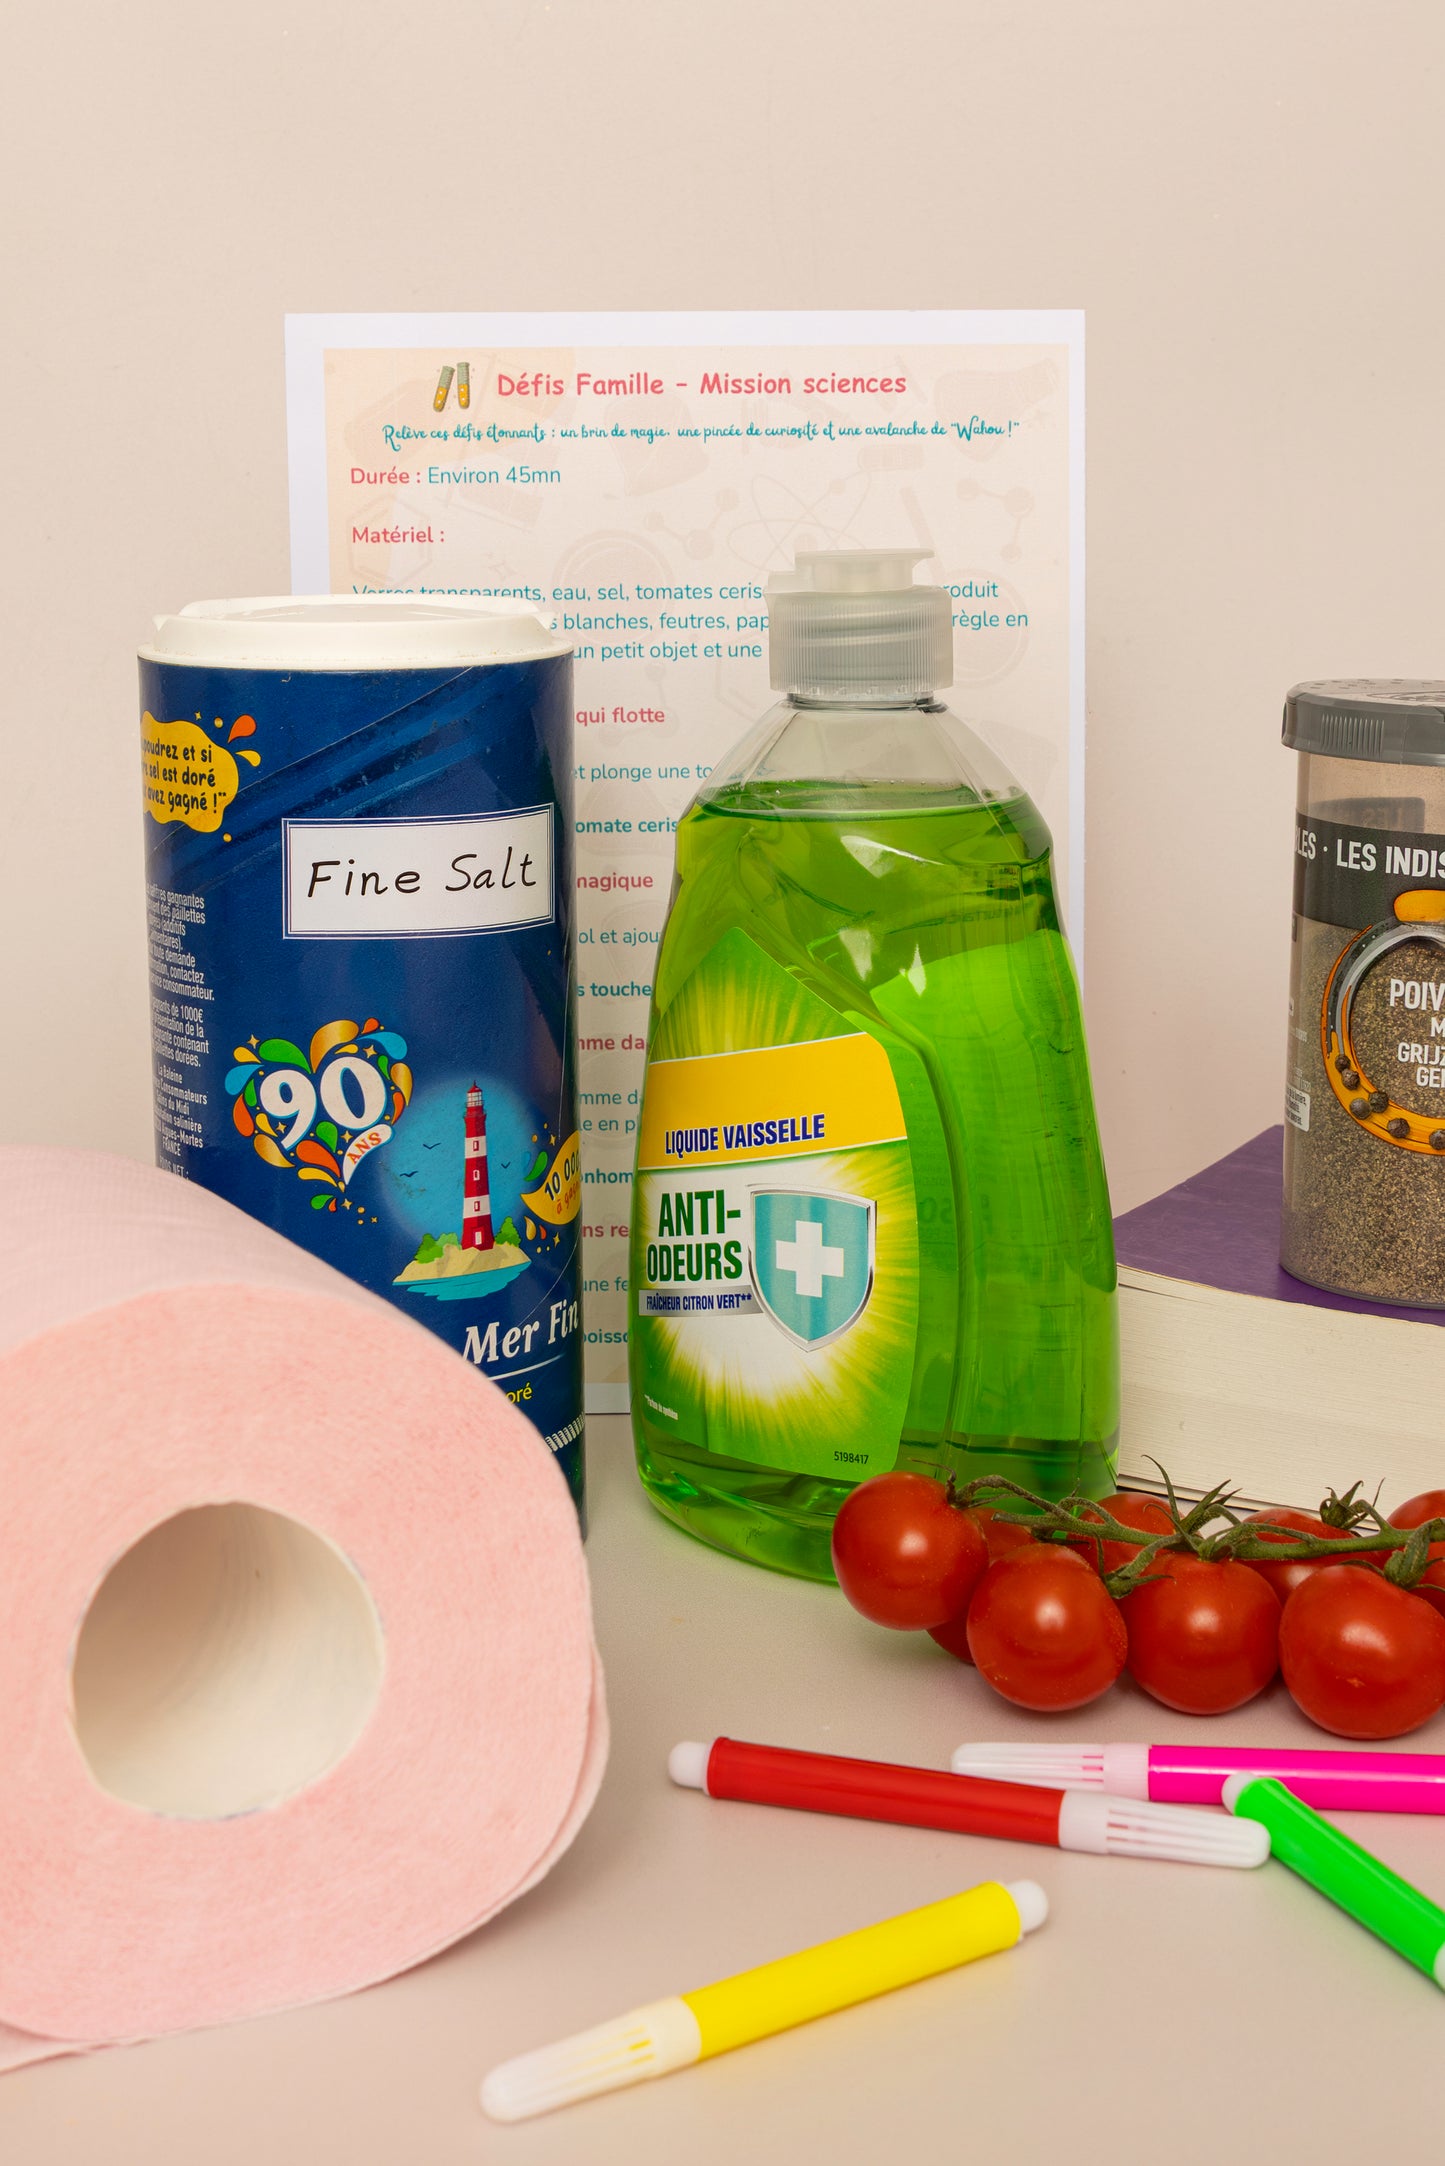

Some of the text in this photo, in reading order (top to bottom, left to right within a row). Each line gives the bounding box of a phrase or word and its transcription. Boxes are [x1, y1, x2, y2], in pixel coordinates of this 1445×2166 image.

[498, 372, 565, 397] Défis
[577, 372, 665, 396] Famille
[700, 372, 792, 395] Mission
[803, 372, 907, 394] sciences
[382, 424, 428, 452] Relève
[430, 430, 449, 442] ces
[453, 424, 483, 442] défis
[486, 422, 547, 443] étonnants
[560, 429, 578, 439] un
[581, 424, 608, 439] brin
[610, 423, 628, 438] de
[677, 427, 701, 437] une
[703, 423, 743, 444] pincée
[746, 421, 763, 437] de
[765, 420, 819, 441] curiosité
[822, 420, 836, 441] et
[838, 424, 862, 436] une
[865, 420, 929, 436] avalanche
[930, 420, 948, 435] de
[351, 466, 411, 485] Durée
[428, 466, 500, 484] Environ
[505, 466, 562, 484] 45mn
[352, 525, 434, 544] Matériel
[552, 586, 591, 601] eau,
[597, 583, 630, 601] sel,
[635, 583, 713, 600] tomates
[719, 582, 763, 599] ceris
[564, 612, 653, 632] blanches,
[659, 612, 730, 631] feutres,
[952, 609, 1000, 631] règle
[1006, 613, 1029, 627] en
[601, 641, 645, 661] petit
[649, 641, 698, 661] objet
[704, 642, 723, 658] et
[728, 643, 762, 658] une
[576, 706, 665, 727] qui flotte
[182, 745, 196, 762] et
[200, 744, 212, 763] si
[162, 766, 178, 783] est
[181, 766, 216, 788] doré
[591, 763, 652, 782] plonge
[658, 766, 691, 780] une
[167, 791, 208, 816] gagné
[575, 818, 633, 833] omate
[1296, 825, 1318, 861] LES
[1336, 838, 1378, 872] LES
[307, 846, 537, 899] Fine Salt
[578, 927, 596, 944] ol
[599, 929, 618, 944] et
[169, 966, 205, 985] contactez
[589, 980, 653, 997] touche
[1389, 978, 1445, 1012] POIV
[180, 1004, 204, 1024] 1000€
[185, 1020, 195, 1037] de
[196, 1023, 205, 1039] la
[259, 1056, 387, 1151] 90
[598, 1119, 619, 1131] en
[665, 1113, 826, 1159] LIQUIDE VAISSELLE
[346, 1131, 383, 1165] ANS
[581, 1167, 634, 1184] nhom
[544, 1171, 561, 1201] 10
[658, 1189, 742, 1238] ANTI-
[646, 1240, 744, 1283] ODEURS
[683, 1294, 714, 1311] CITRON
[462, 1299, 579, 1365] Mer Fin
[833, 1450, 870, 1466] 5198417
